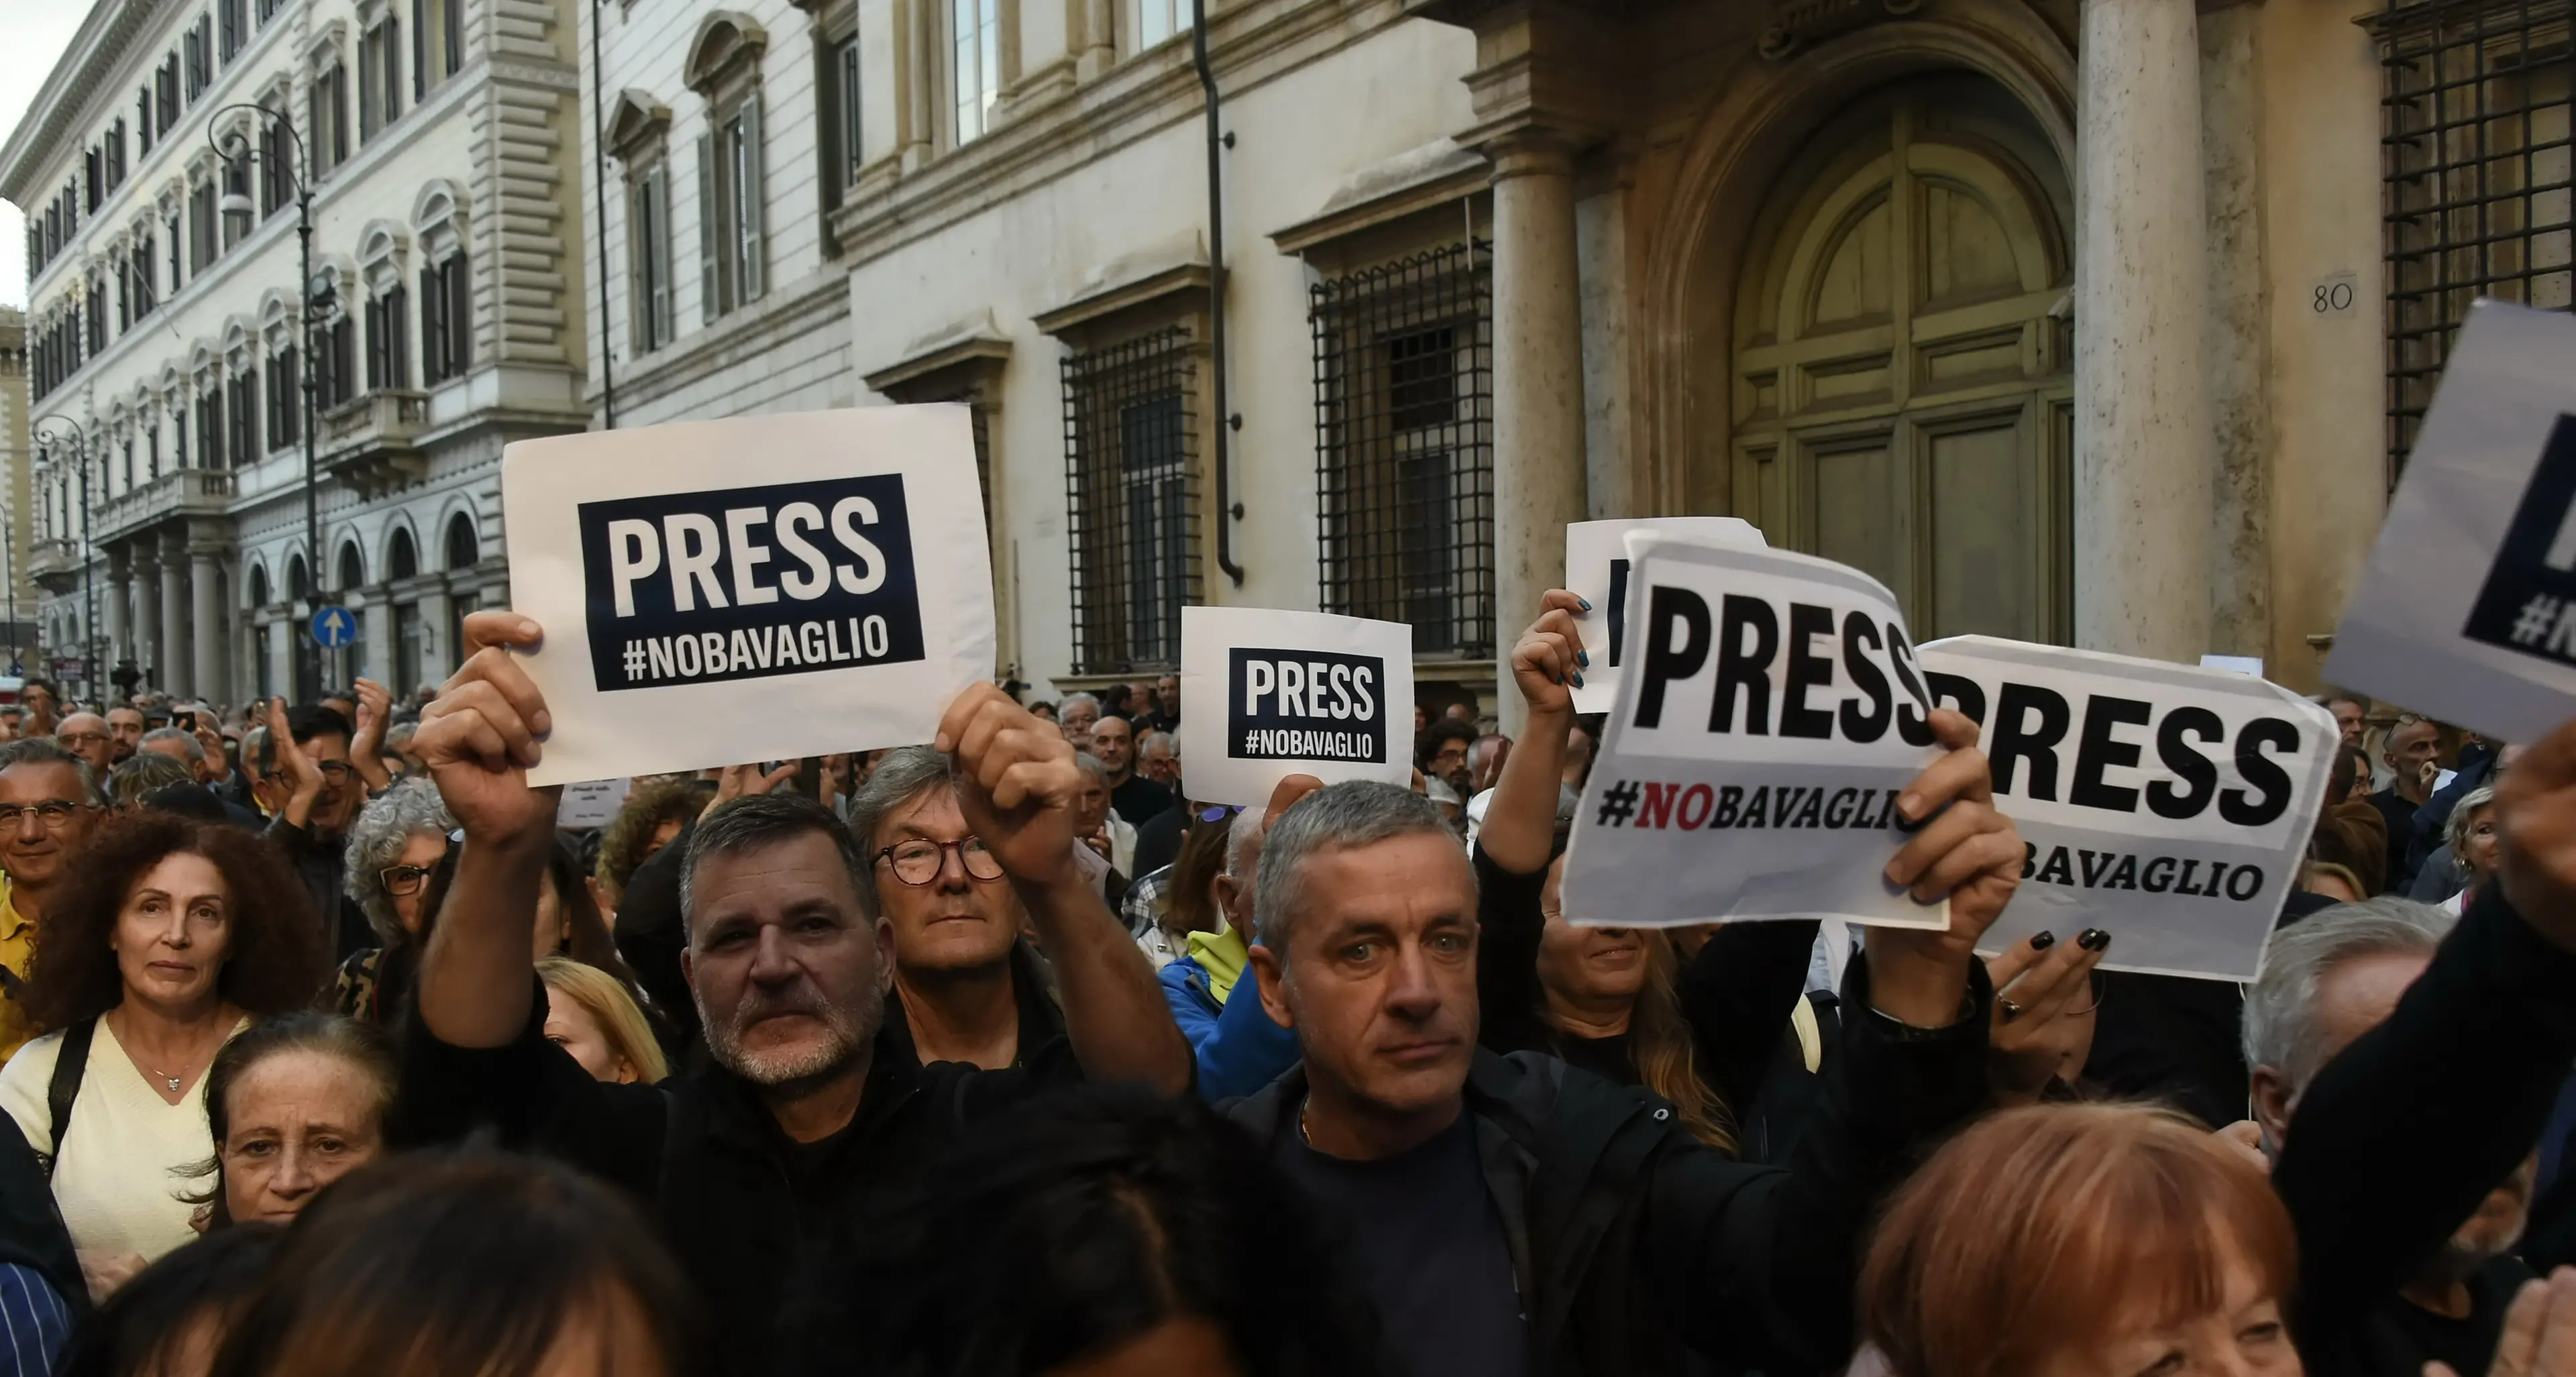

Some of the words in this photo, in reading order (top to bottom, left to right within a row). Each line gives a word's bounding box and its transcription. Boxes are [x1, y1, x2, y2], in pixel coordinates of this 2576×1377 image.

[2314, 283, 2353, 313] 80
[608, 496, 887, 618] PRESS
[623, 615, 890, 681] #NOBAVAGLIO
[1632, 584, 1938, 747] PRESS
[1246, 659, 1374, 722] PRESS
[1245, 729, 1373, 759] #NOBAVAGLIO
